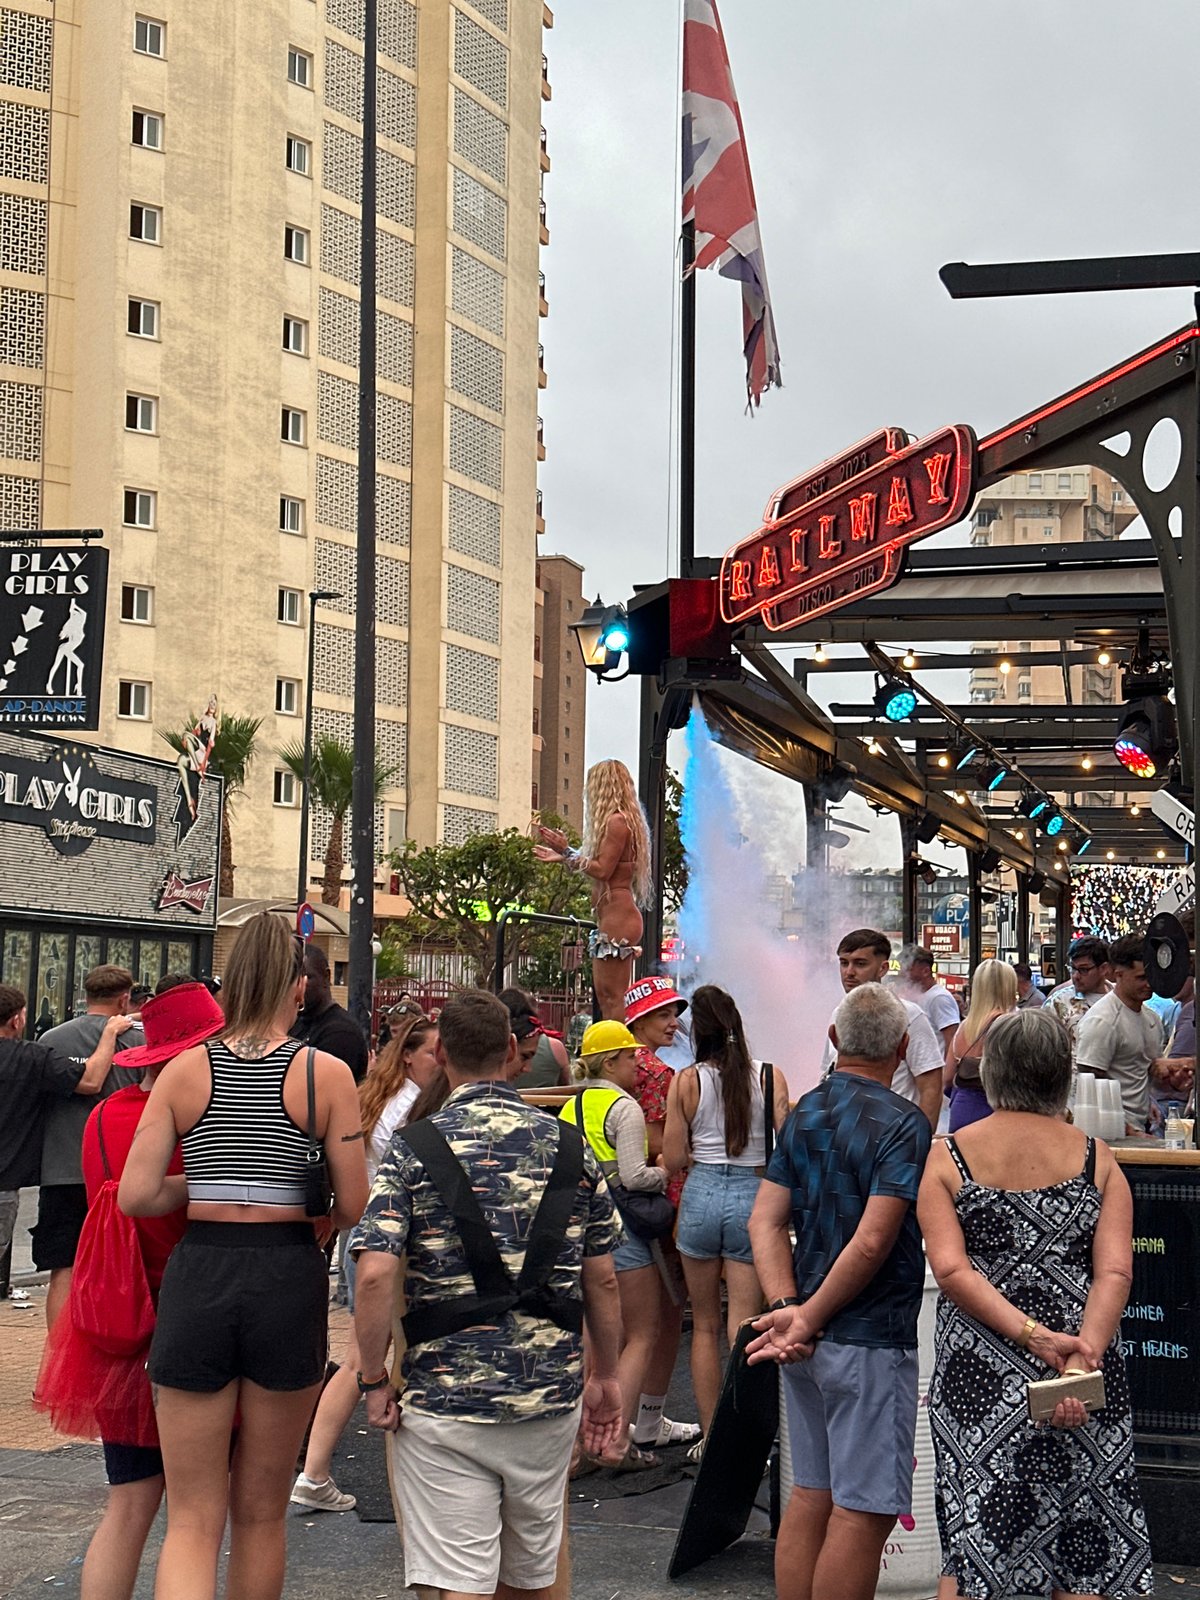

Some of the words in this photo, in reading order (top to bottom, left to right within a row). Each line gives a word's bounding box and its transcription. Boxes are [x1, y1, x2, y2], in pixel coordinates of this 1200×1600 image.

[839, 452, 868, 485] 2023
[729, 451, 953, 602] RAILWAY
[10, 552, 89, 573] PLAY
[4, 574, 90, 596] GIRLS
[798, 583, 833, 616] DISCO
[852, 564, 876, 588] PUB
[78, 786, 154, 829] GIRLS
[1173, 866, 1196, 903] RA
[929, 944, 953, 953] MARKET
[932, 936, 951, 944] SUPER
[1132, 1236, 1166, 1255] HANA
[1142, 1340, 1190, 1359] HELENS
[884, 1543, 904, 1556] ON
